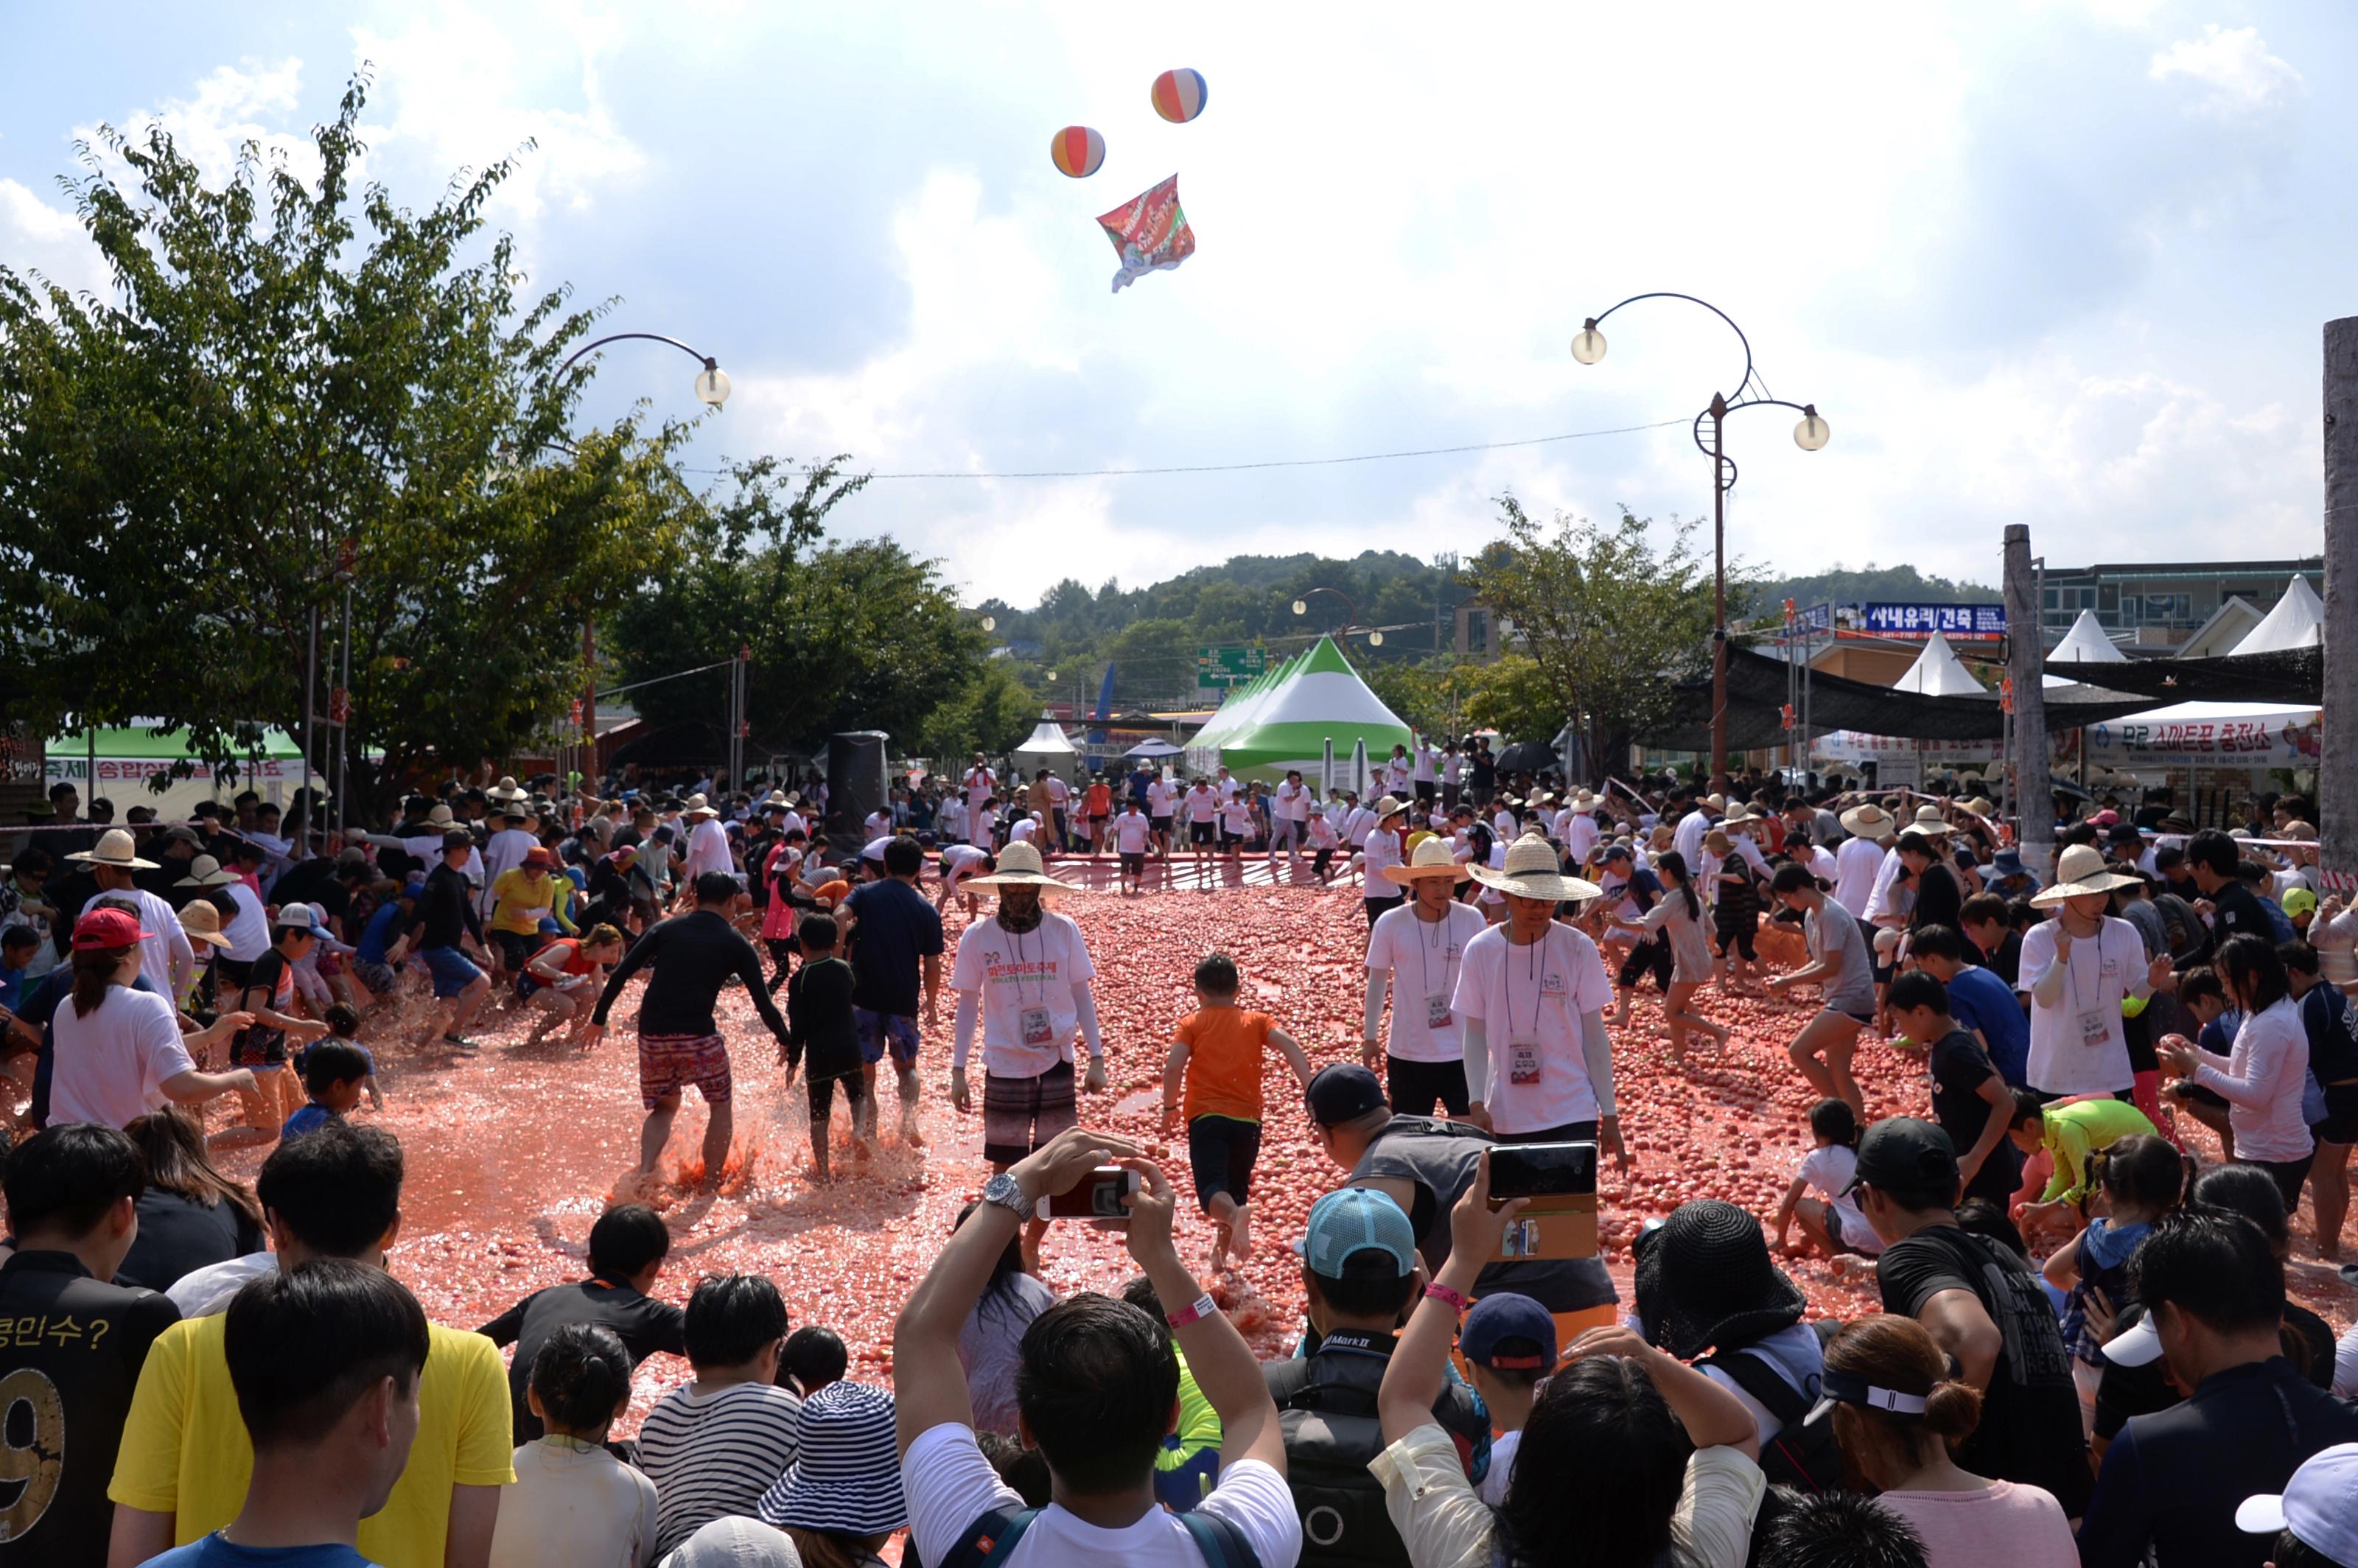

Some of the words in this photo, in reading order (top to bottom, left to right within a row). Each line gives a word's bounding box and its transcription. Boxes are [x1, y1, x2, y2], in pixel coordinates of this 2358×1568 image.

[1870, 606, 1973, 629] 사내유리/건축
[2121, 726, 2149, 751] 무료
[2153, 724, 2215, 753] 스마트폰
[2218, 722, 2273, 752] 충전소
[46, 760, 87, 779] 축제
[1332, 1335, 1359, 1345] Mark
